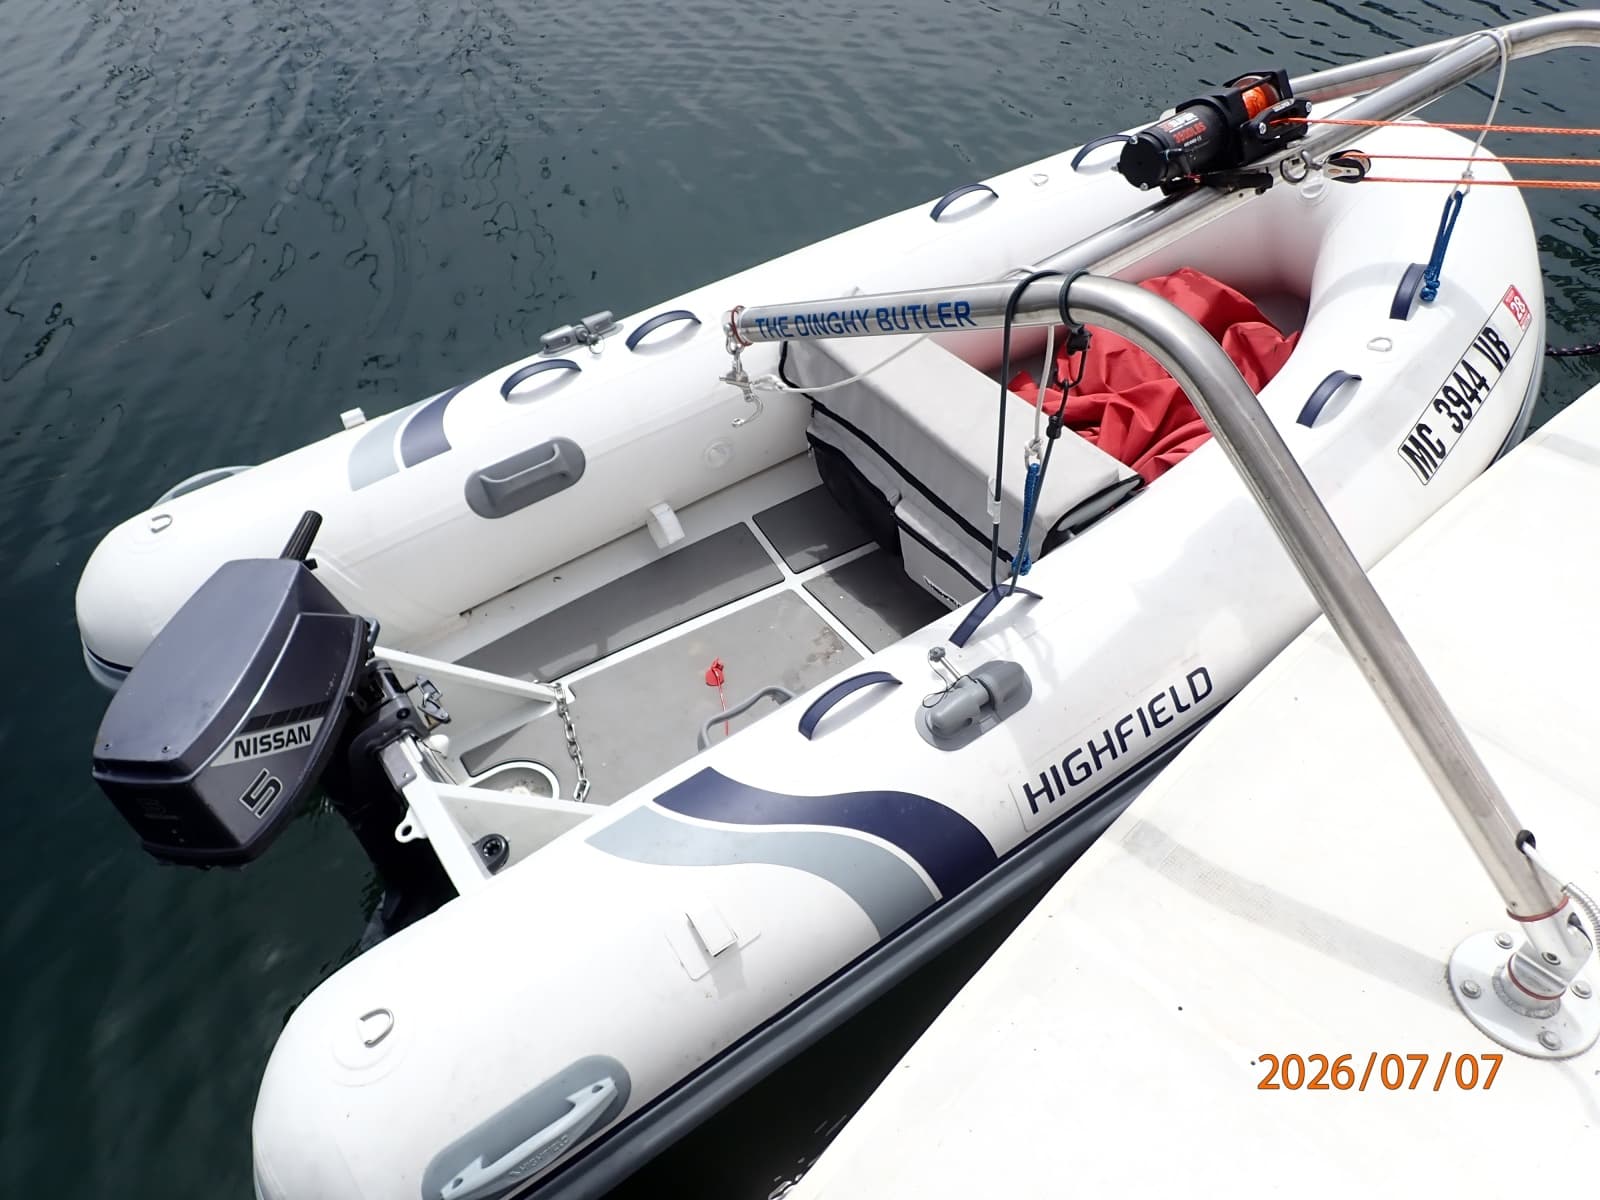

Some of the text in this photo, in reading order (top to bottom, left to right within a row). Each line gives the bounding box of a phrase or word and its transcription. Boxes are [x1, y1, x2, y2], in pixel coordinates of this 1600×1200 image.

[755, 301, 977, 338] THE DINGHY BUTLER
[1510, 295, 1526, 321] 28
[1401, 326, 1511, 480] MC 3944 VB
[233, 724, 311, 759] NISSAN
[1022, 666, 1213, 815] HIGHFIELD
[239, 767, 283, 819] 5
